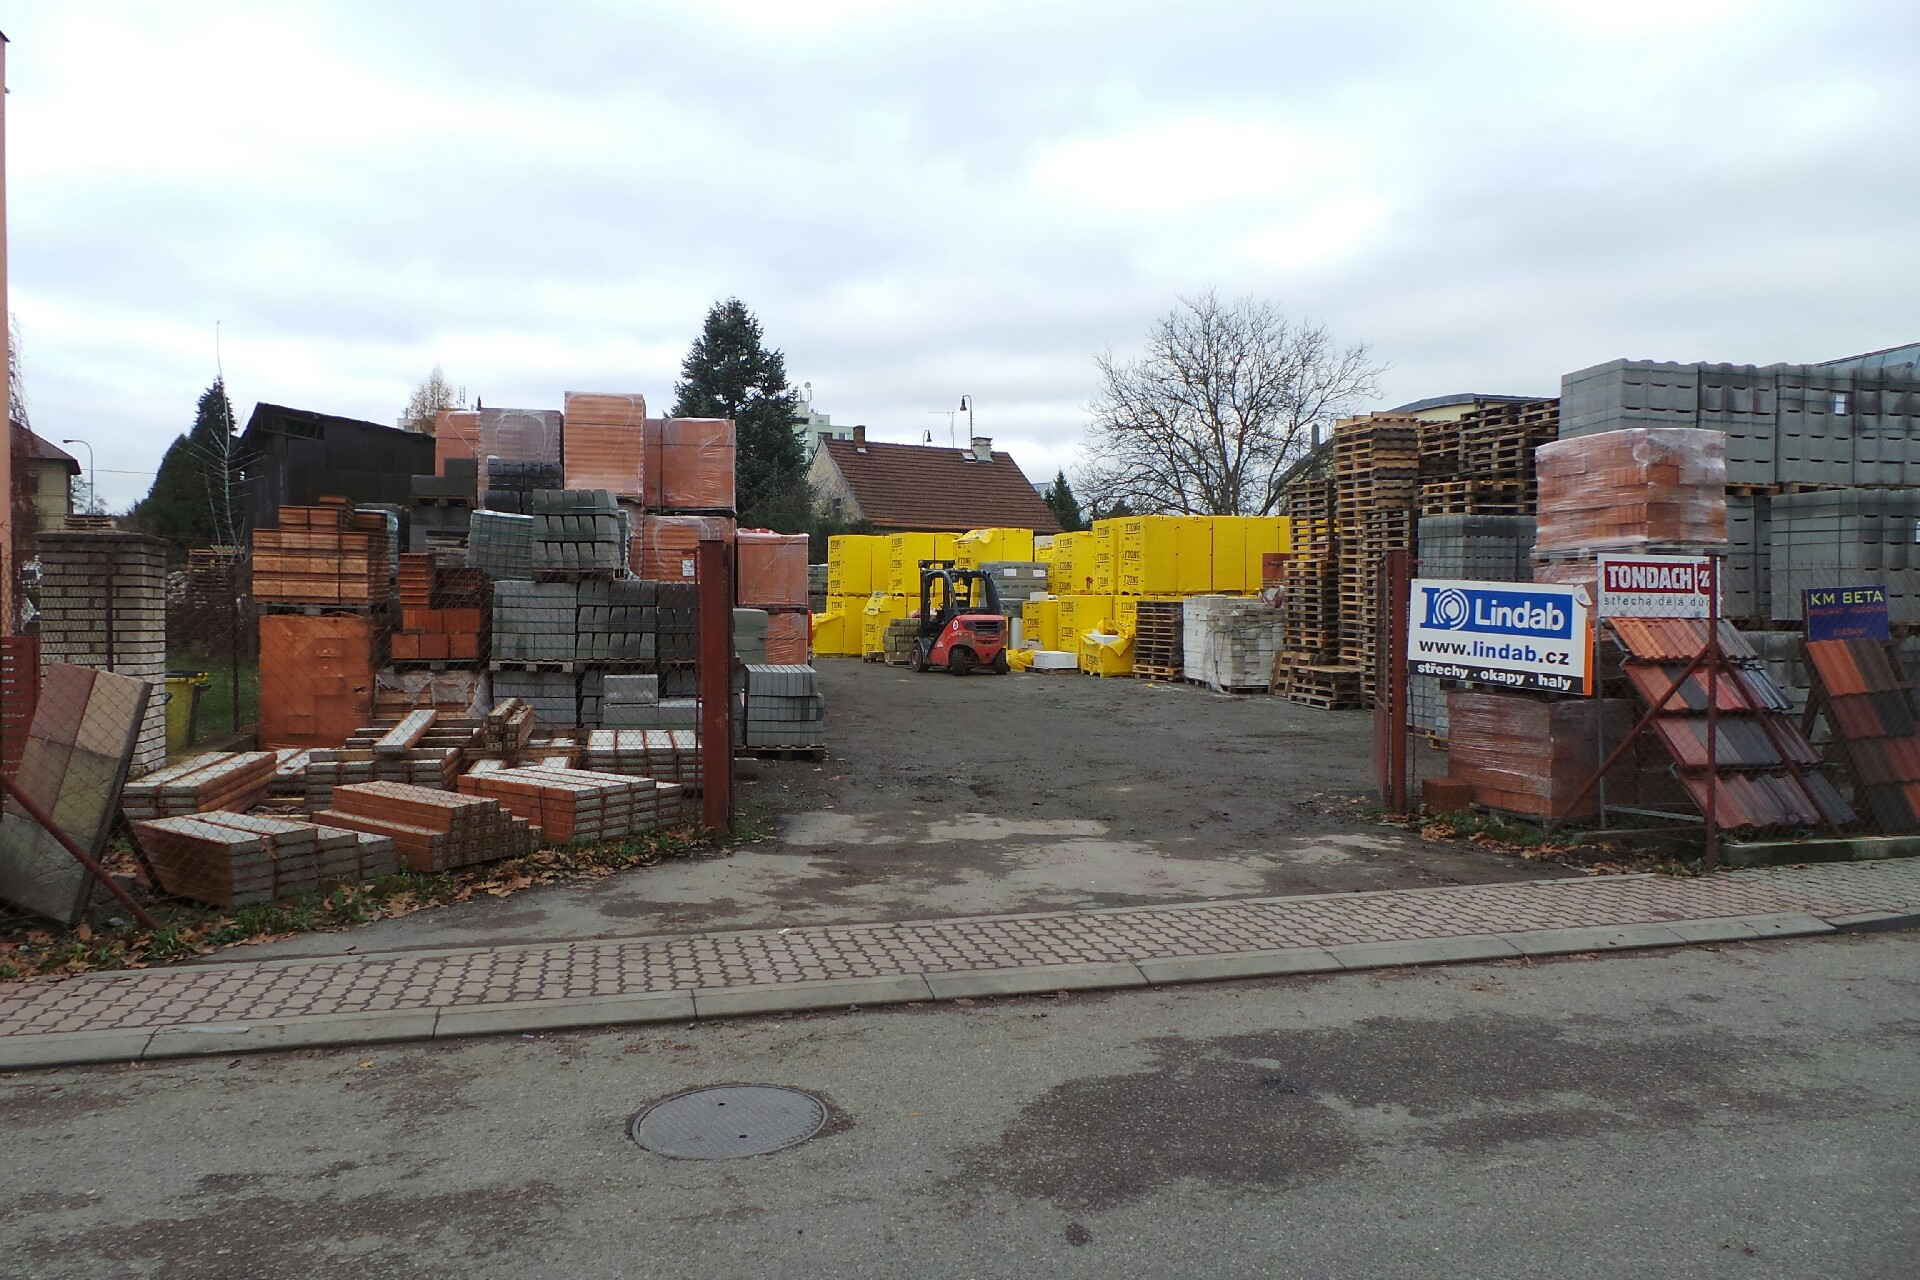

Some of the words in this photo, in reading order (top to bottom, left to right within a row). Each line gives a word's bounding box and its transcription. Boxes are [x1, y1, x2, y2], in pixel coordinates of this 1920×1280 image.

[1607, 565, 1693, 590] TONDACH
[1604, 595, 1652, 606] střecha
[1811, 592, 1836, 605] KM
[1842, 590, 1884, 604] BETA
[1475, 598, 1565, 631] Lindab
[1418, 639, 1570, 666] www.lindab.cz
[1417, 662, 1469, 679] střechy
[1480, 669, 1526, 685] okapy
[1538, 672, 1572, 691] haly
